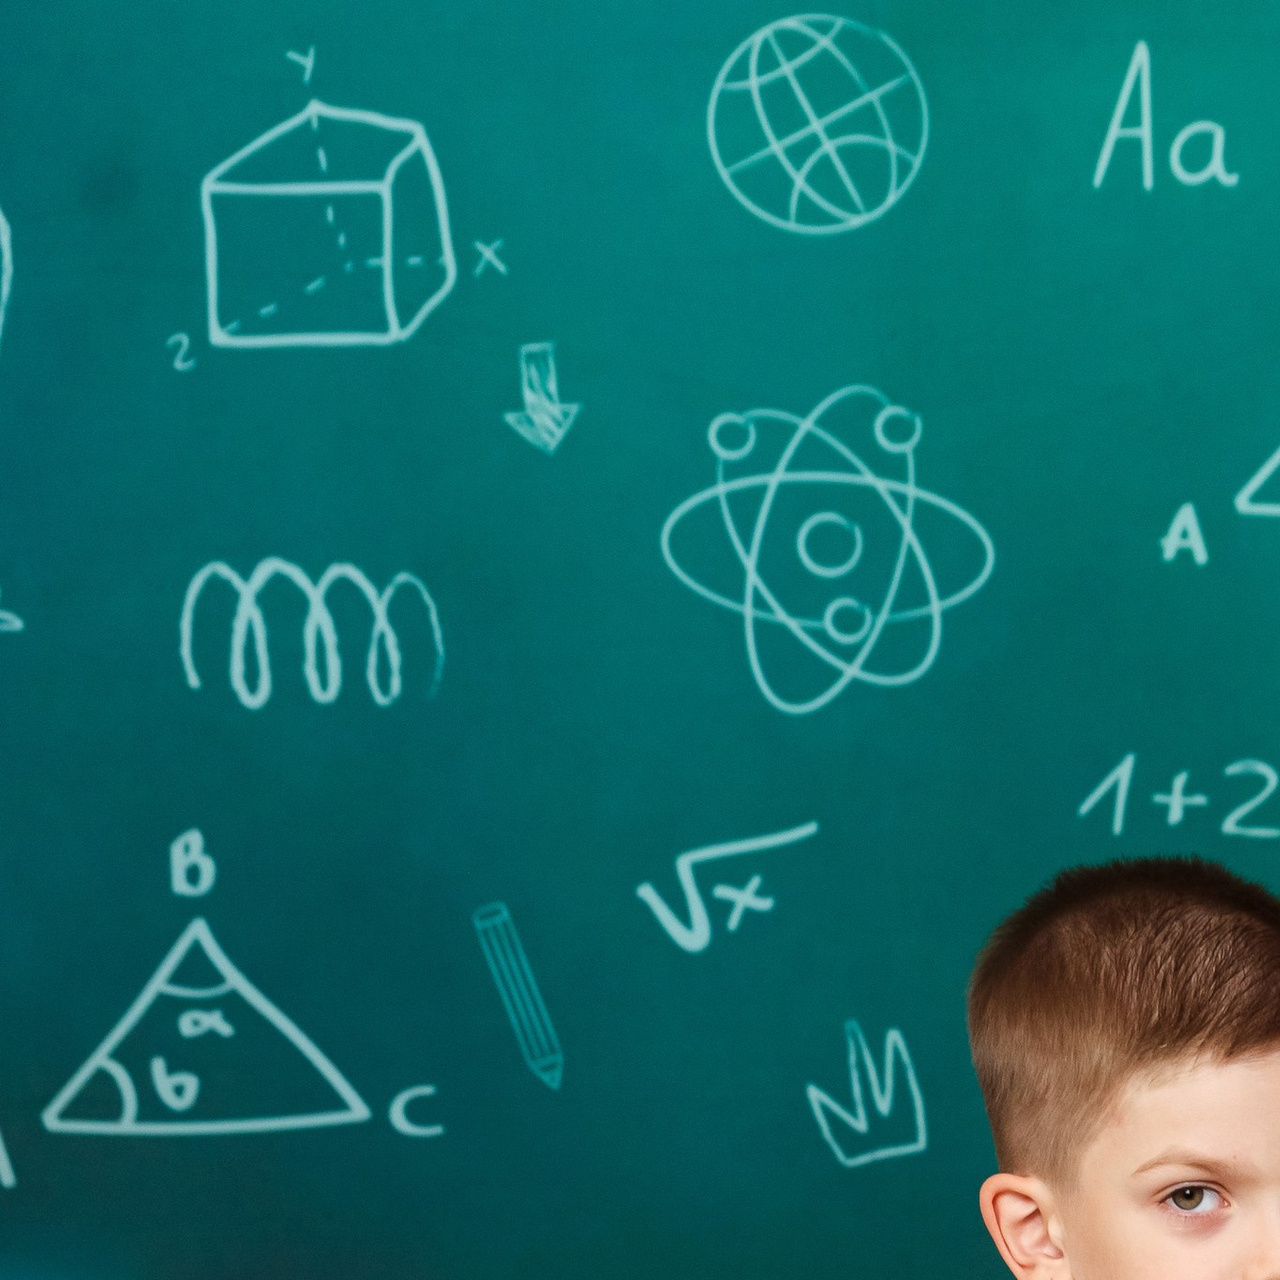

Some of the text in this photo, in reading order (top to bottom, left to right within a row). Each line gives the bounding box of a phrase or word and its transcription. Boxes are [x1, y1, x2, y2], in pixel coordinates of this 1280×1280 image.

[1092, 38, 1241, 192] Aa
[1160, 502, 1209, 566] A
[169, 828, 217, 897] B
